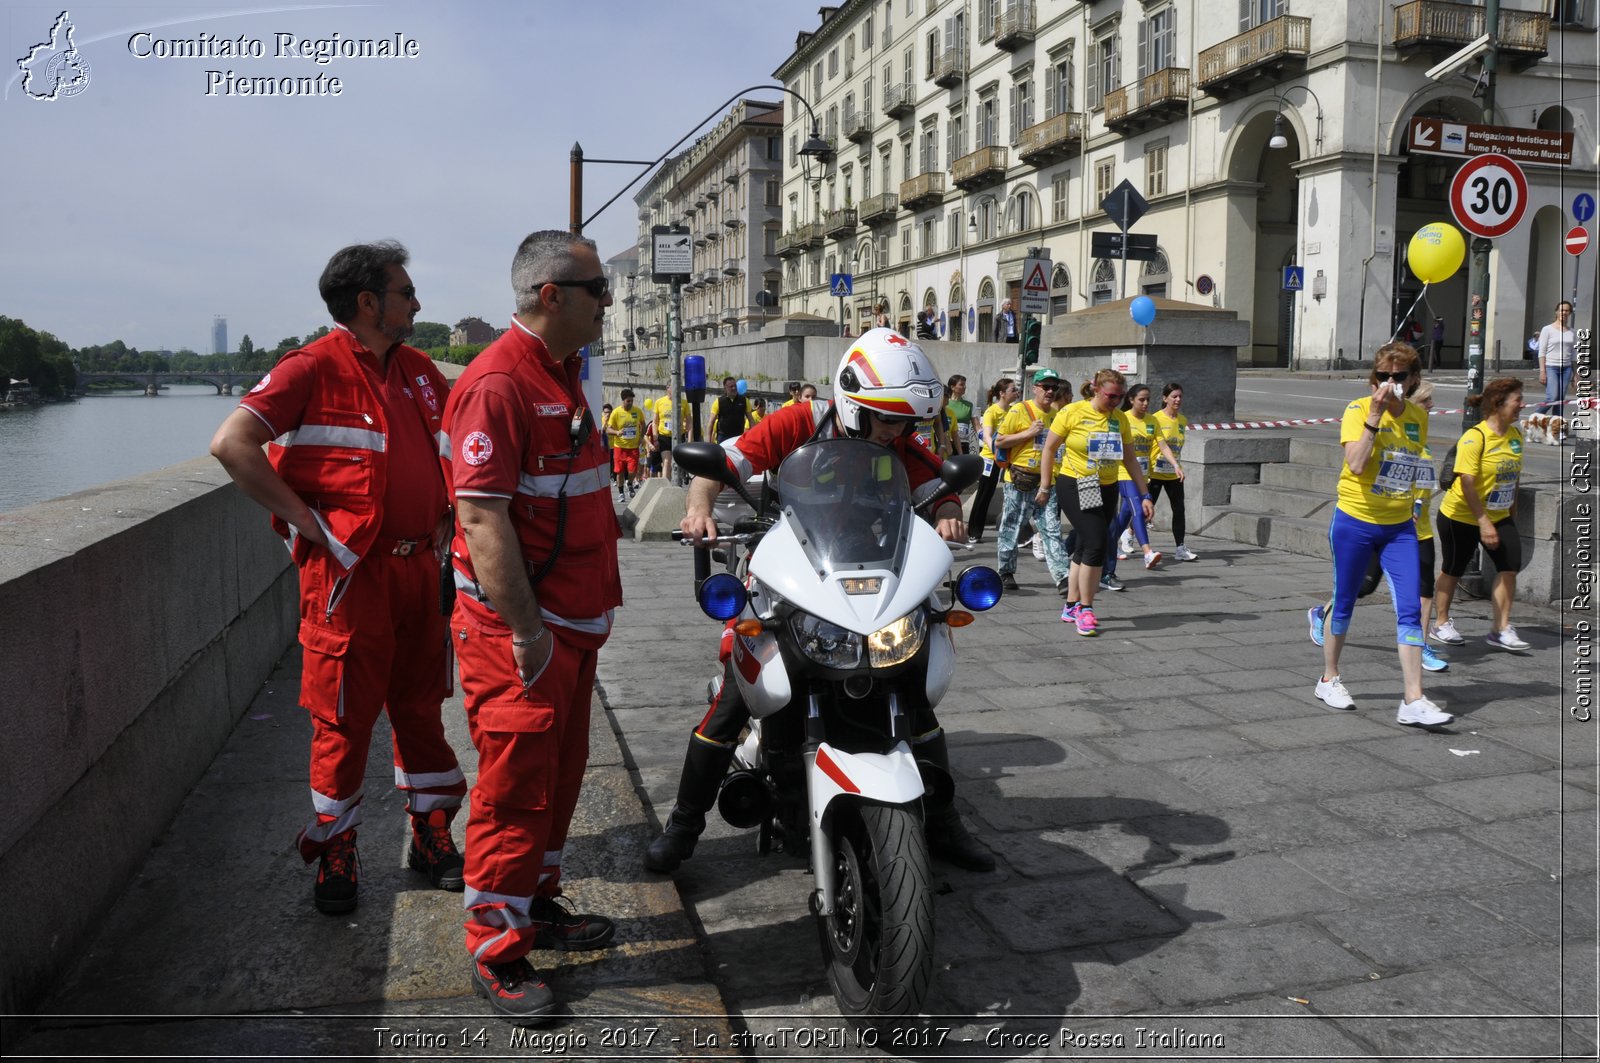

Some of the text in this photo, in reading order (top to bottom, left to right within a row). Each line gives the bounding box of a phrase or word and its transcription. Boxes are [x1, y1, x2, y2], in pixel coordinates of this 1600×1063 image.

[1469, 132, 1562, 146] navigazione turistica sul
[1468, 143, 1490, 153] fiume
[1491, 145, 1502, 154] Po
[1507, 147, 1539, 157] imbarco
[1540, 150, 1570, 160] Murazzi
[1470, 176, 1512, 215] 30
[1386, 463, 1415, 483] 8959
